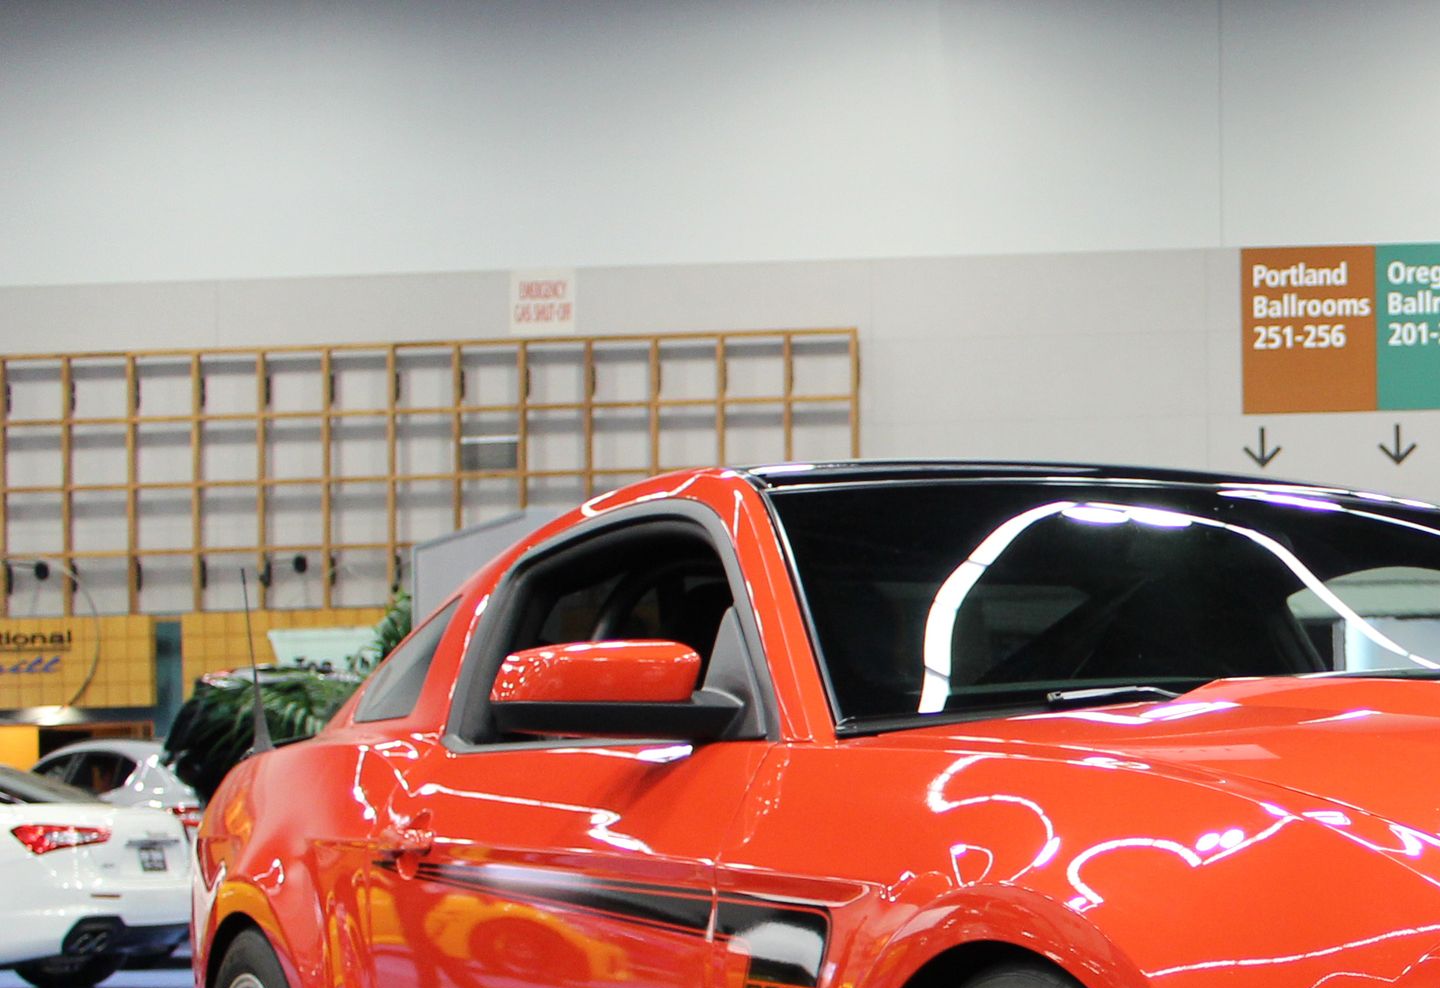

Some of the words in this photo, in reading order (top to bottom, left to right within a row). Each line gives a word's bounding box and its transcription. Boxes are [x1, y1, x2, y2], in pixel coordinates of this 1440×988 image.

[1252, 261, 1348, 289] Portland
[1253, 293, 1372, 319] Ballrooms
[1253, 324, 1347, 350] 251-256
